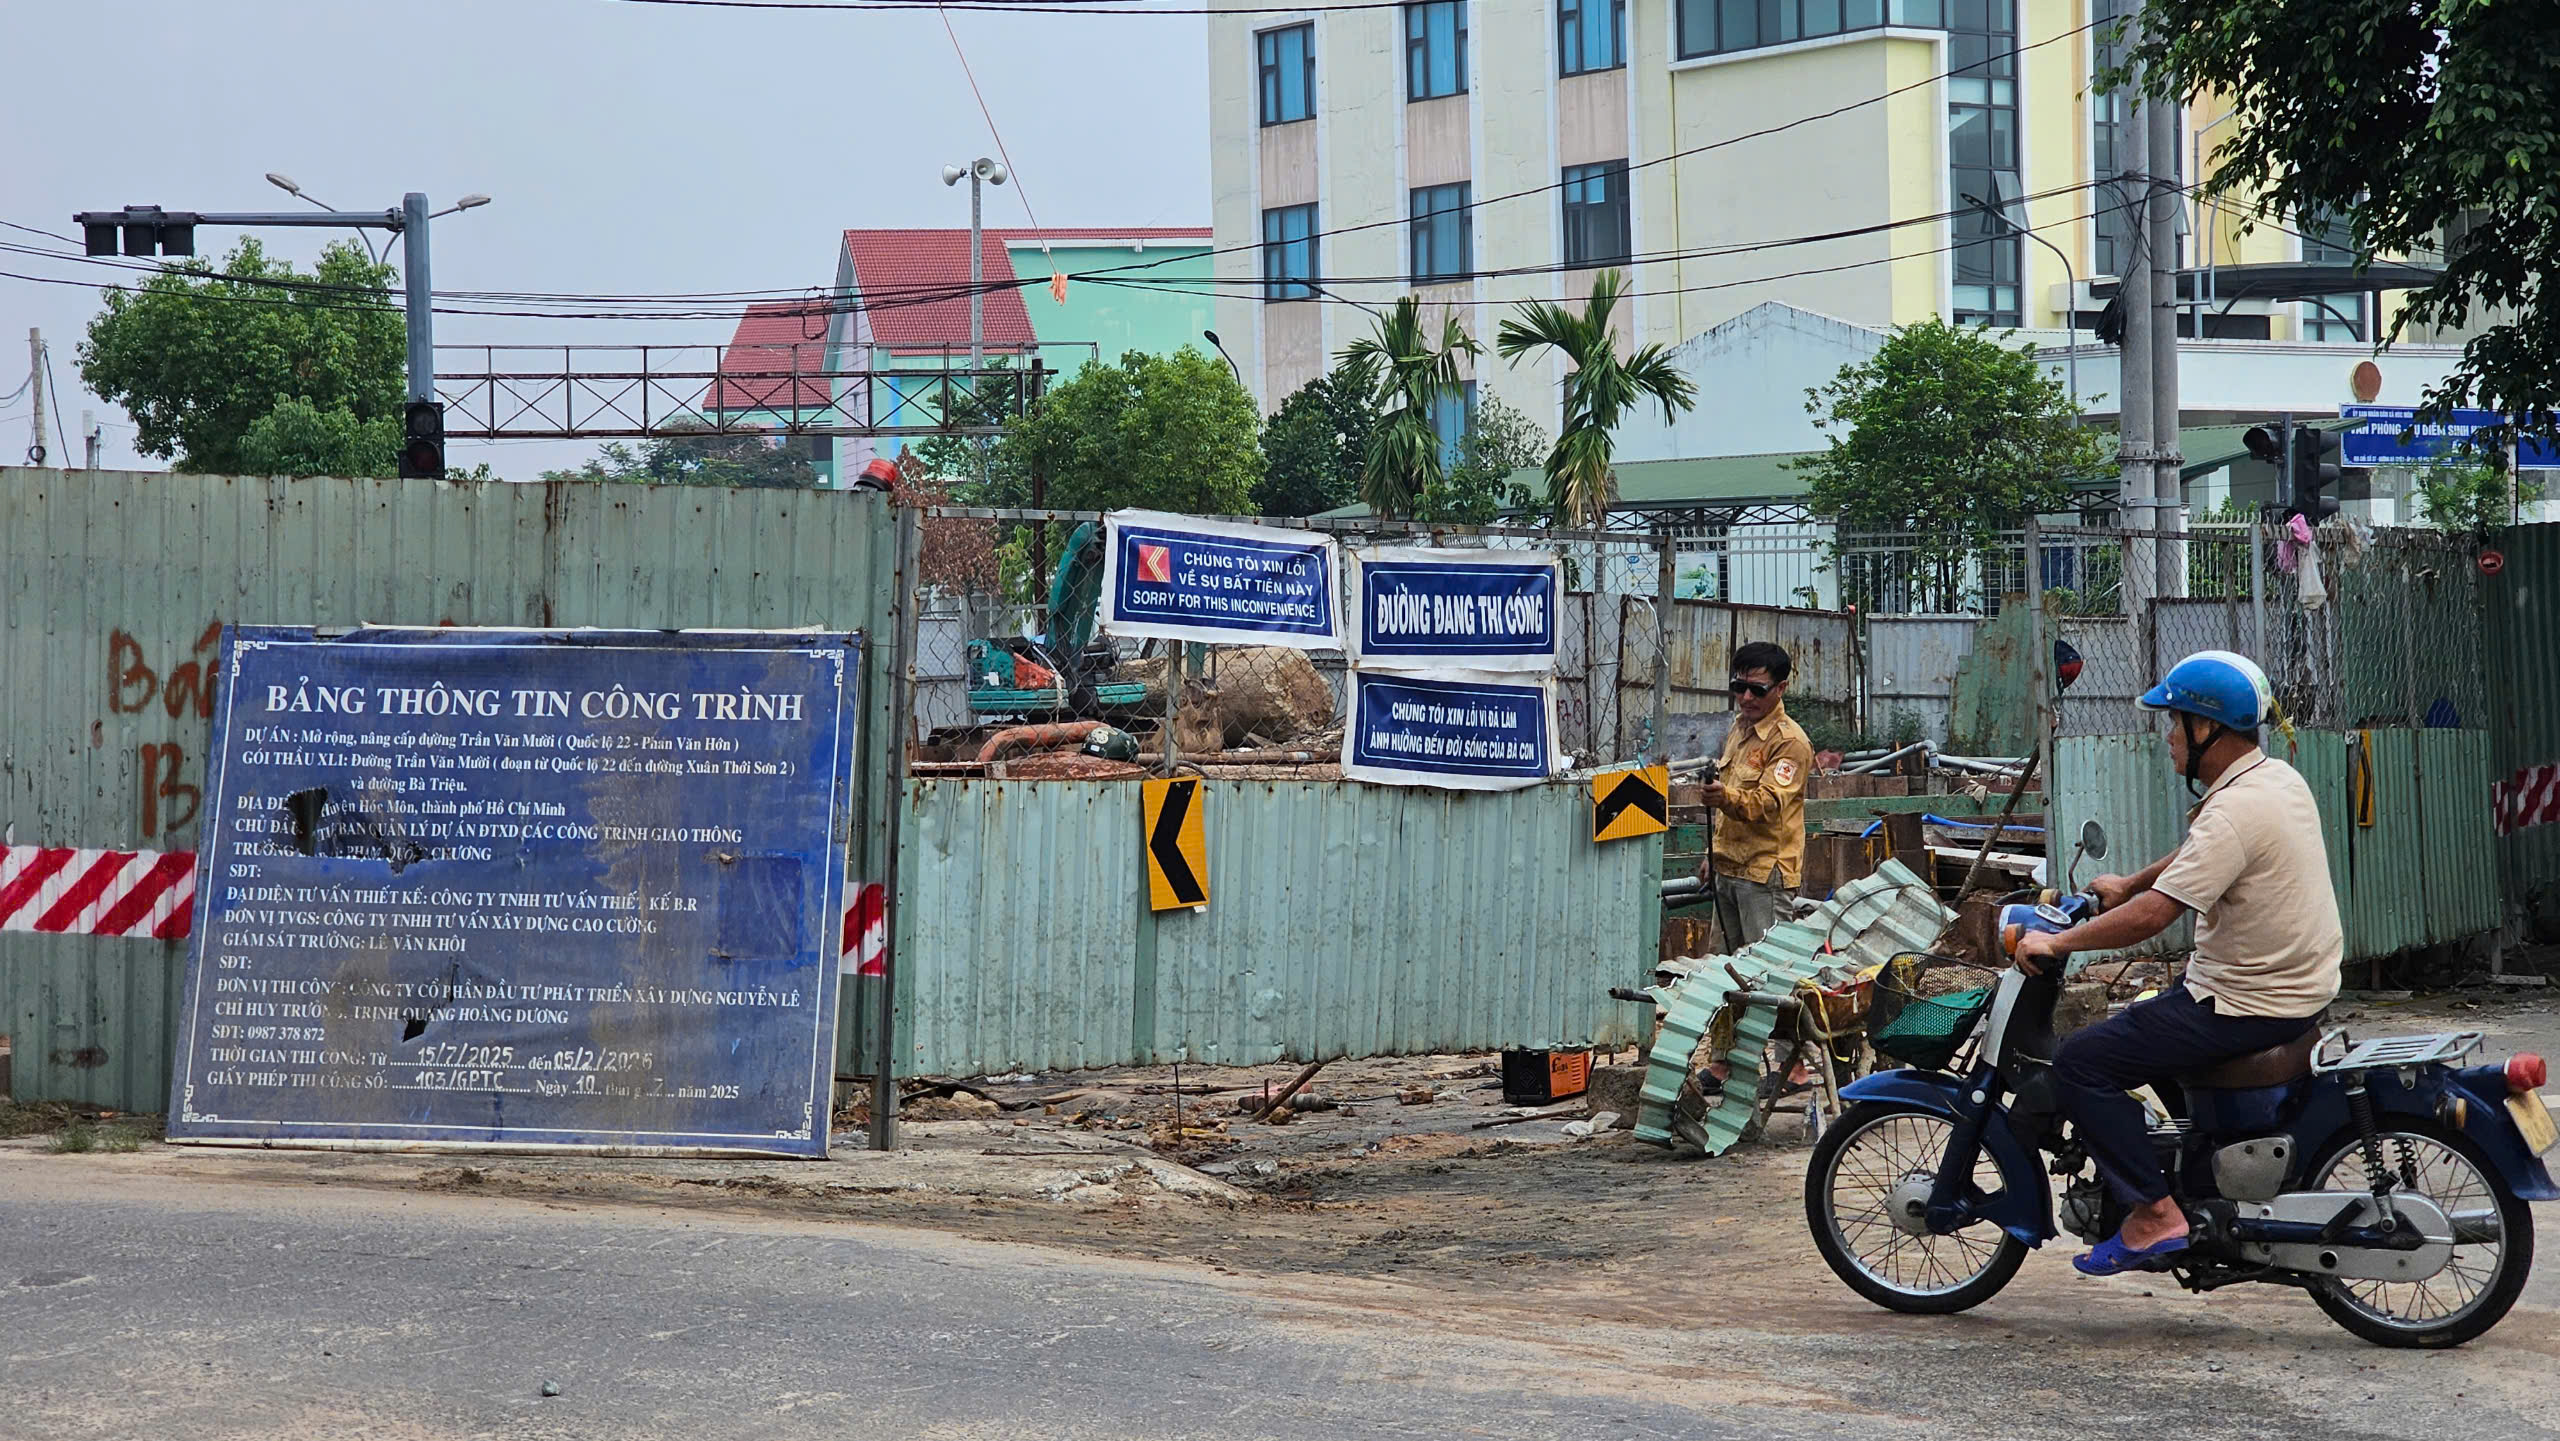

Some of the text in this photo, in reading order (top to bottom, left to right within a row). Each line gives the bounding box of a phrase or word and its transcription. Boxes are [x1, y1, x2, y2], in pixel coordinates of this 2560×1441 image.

[1184, 551, 1305, 577] CHÚNG TÔI XIN LỖI
[1179, 568, 1314, 597] VỀ SỰ BẤT TIỆN NÀY
[1133, 590, 1316, 619] SORRY FOR THIS INCONVENIENCE
[1377, 582, 1543, 636] ĐƯỜNG ĐANG THI CÔNG
[265, 676, 803, 721] BẢNG THÔNG TIN CÔNG TRÌNH
[1392, 698, 1517, 729] CHÚNG TÔI XIN LỖI ĐÃ LÀM
[245, 727, 702, 751] DỰ Mở rộng, nâng cấp đường Trần Văn Mười Quốc 22 Phan Văn
[1370, 724, 1389, 750] ẢNH
[1425, 730, 1444, 756] ĐẾN
[1446, 733, 1462, 757] ĐỜI
[1464, 733, 1488, 759] SỐNG
[1489, 735, 1505, 760] CỦA
[1507, 738, 1518, 761] BÀ
[1519, 743, 1534, 761] CON
[242, 745, 777, 777] GÓI THẦU Đường Trần Văn Mười đoạn từ Quốc 22 đến đường Xuân Sơn
[351, 774, 467, 793] và Bà Triệu.
[237, 795, 566, 817] ĐỊA thành phố Hồ Chí Minh
[235, 814, 742, 843] CHỦ LÝ DỰ ÁN ĐTXD CÁC CÔNG TRÌNH GIAO THÔNG
[229, 864, 261, 879] SĐT:
[227, 883, 697, 912] ĐẠI DIỆN TƯ VẤN THIẾT KẾ: CÔNG TY TNHH TƯ VẤN KẾ B.R
[225, 908, 603, 934] ĐƠN VỊ TVGS: CÔNG TY TNHH TƯ VẤN XÂY DỰNG CAO
[223, 931, 466, 952] GIÁM SÁT VĂN KHÔI
[219, 955, 252, 970] SĐT:
[217, 977, 800, 1008] ĐƠN VỊ THI TY CỔ ĐẦU TƯ PHÁT TRIỂN XÂY DỰNG NGUYỄN LÊ
[215, 996, 569, 1024] CHỈ HUY HOÀNG DƯƠNG
[212, 1025, 325, 1041] SĐT: 0987 378 872
[210, 1045, 246, 1062] THỜI
[251, 1049, 288, 1064] GIAN
[290, 1050, 316, 1064] THI
[528, 1055, 552, 1070] đến
[207, 1067, 739, 1099] GIẤY PHÉP THI SỐ: Ngày năm 2025
